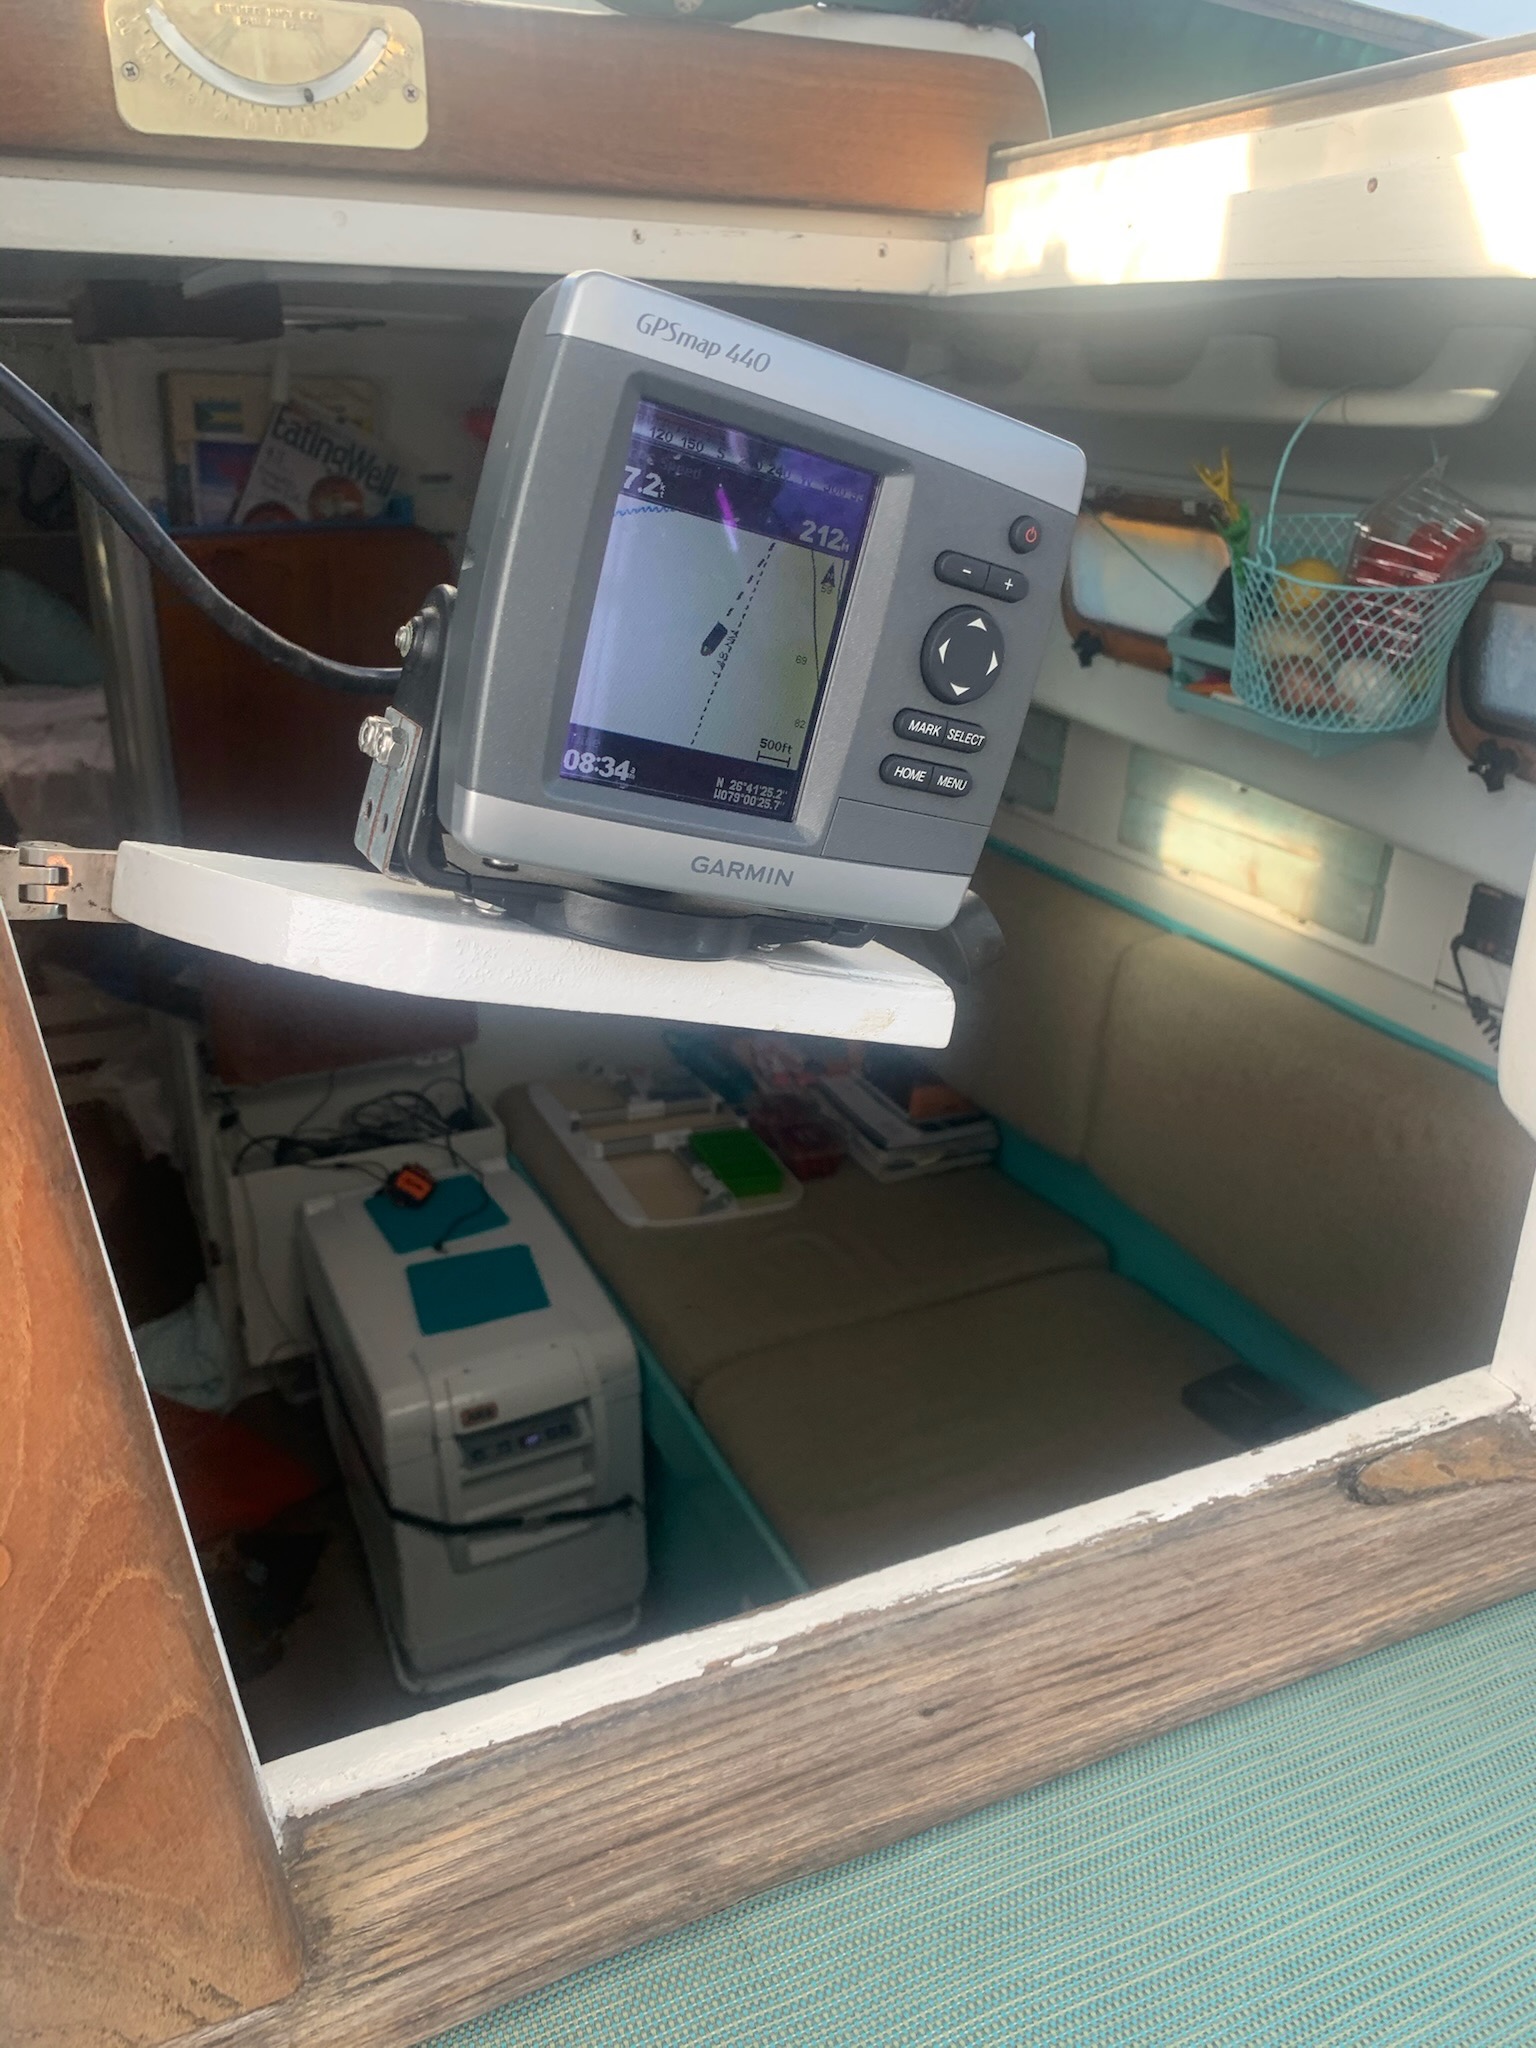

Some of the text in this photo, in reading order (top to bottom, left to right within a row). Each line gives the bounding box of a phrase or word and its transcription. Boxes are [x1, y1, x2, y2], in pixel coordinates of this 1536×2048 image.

[636, 313, 771, 373] GPSmap 440
[649, 426, 673, 443] 120
[681, 436, 704, 453] 150
[622, 465, 661, 499] 7.2
[799, 519, 845, 552] 212
[759, 737, 793, 755] 500ft
[908, 719, 985, 747] MARK SELECT
[563, 748, 631, 782] 08:34
[893, 765, 968, 791] HOME MENU
[716, 776, 725, 788] N
[691, 855, 794, 887] GARMIN
